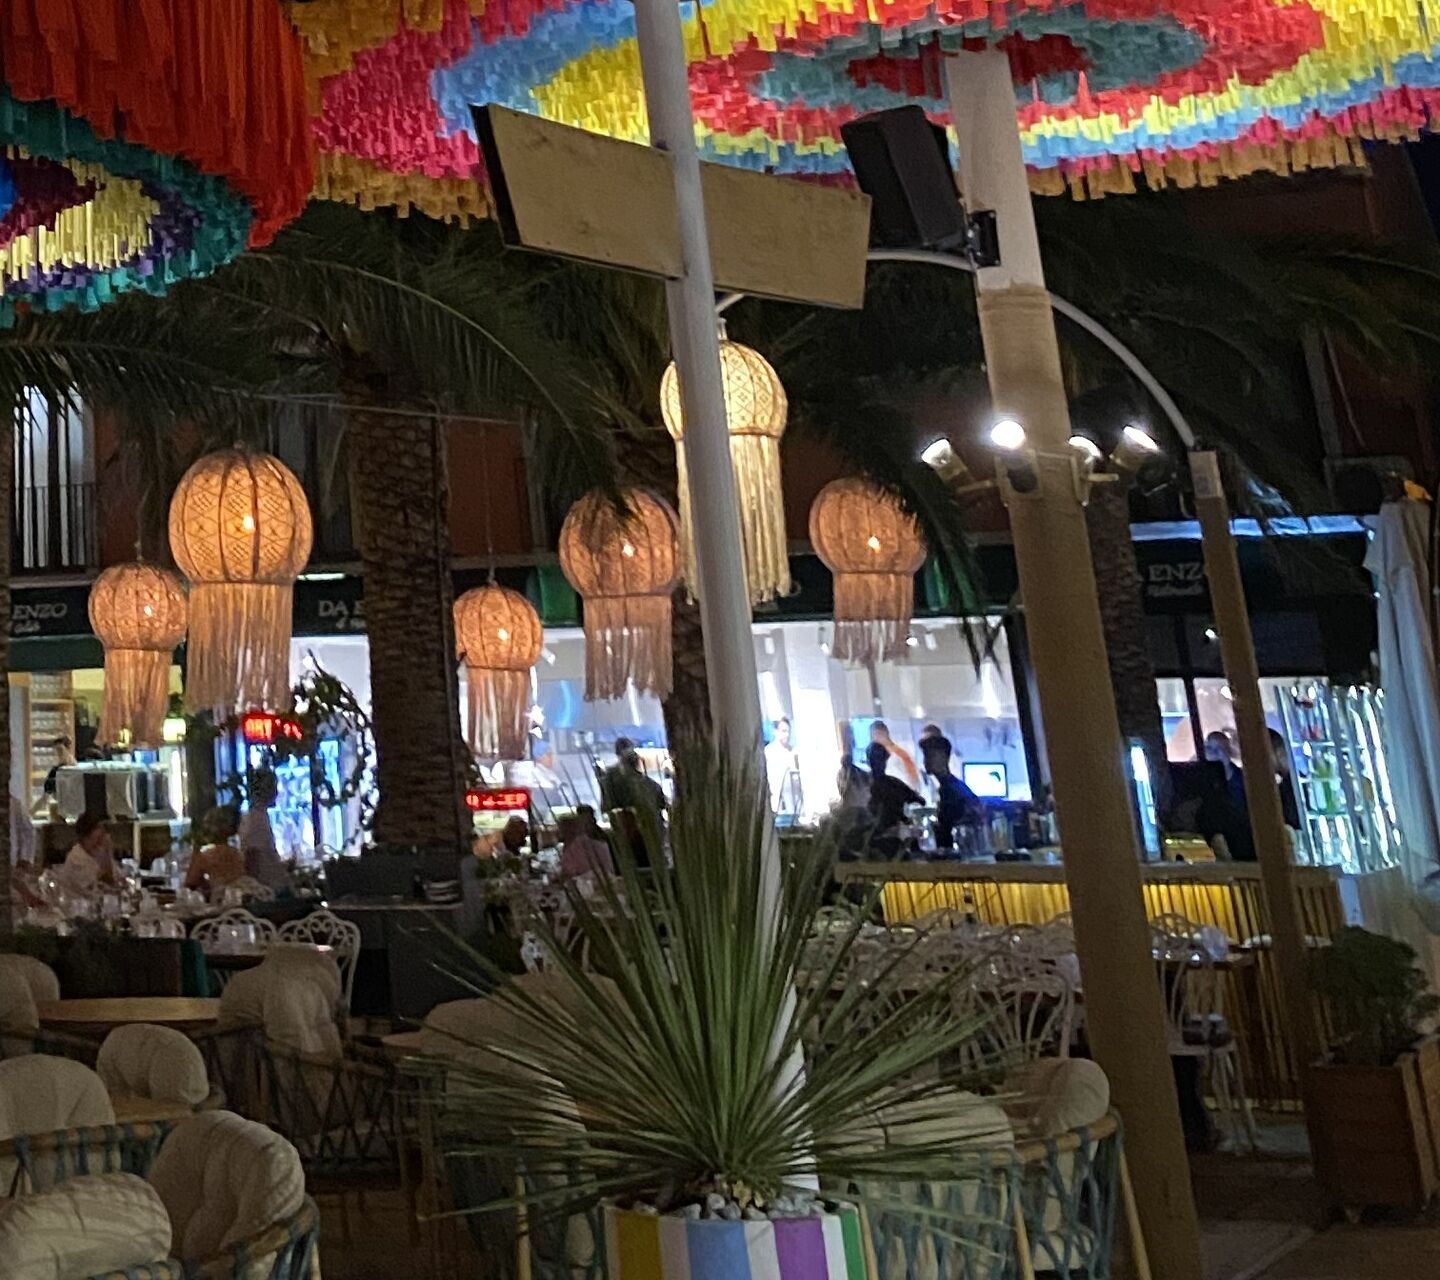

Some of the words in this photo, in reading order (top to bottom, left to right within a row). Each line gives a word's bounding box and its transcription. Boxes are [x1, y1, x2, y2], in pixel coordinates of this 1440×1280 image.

[1147, 561, 1203, 581] ENZ
[12, 602, 68, 620] ENZO
[318, 600, 349, 617] DA
